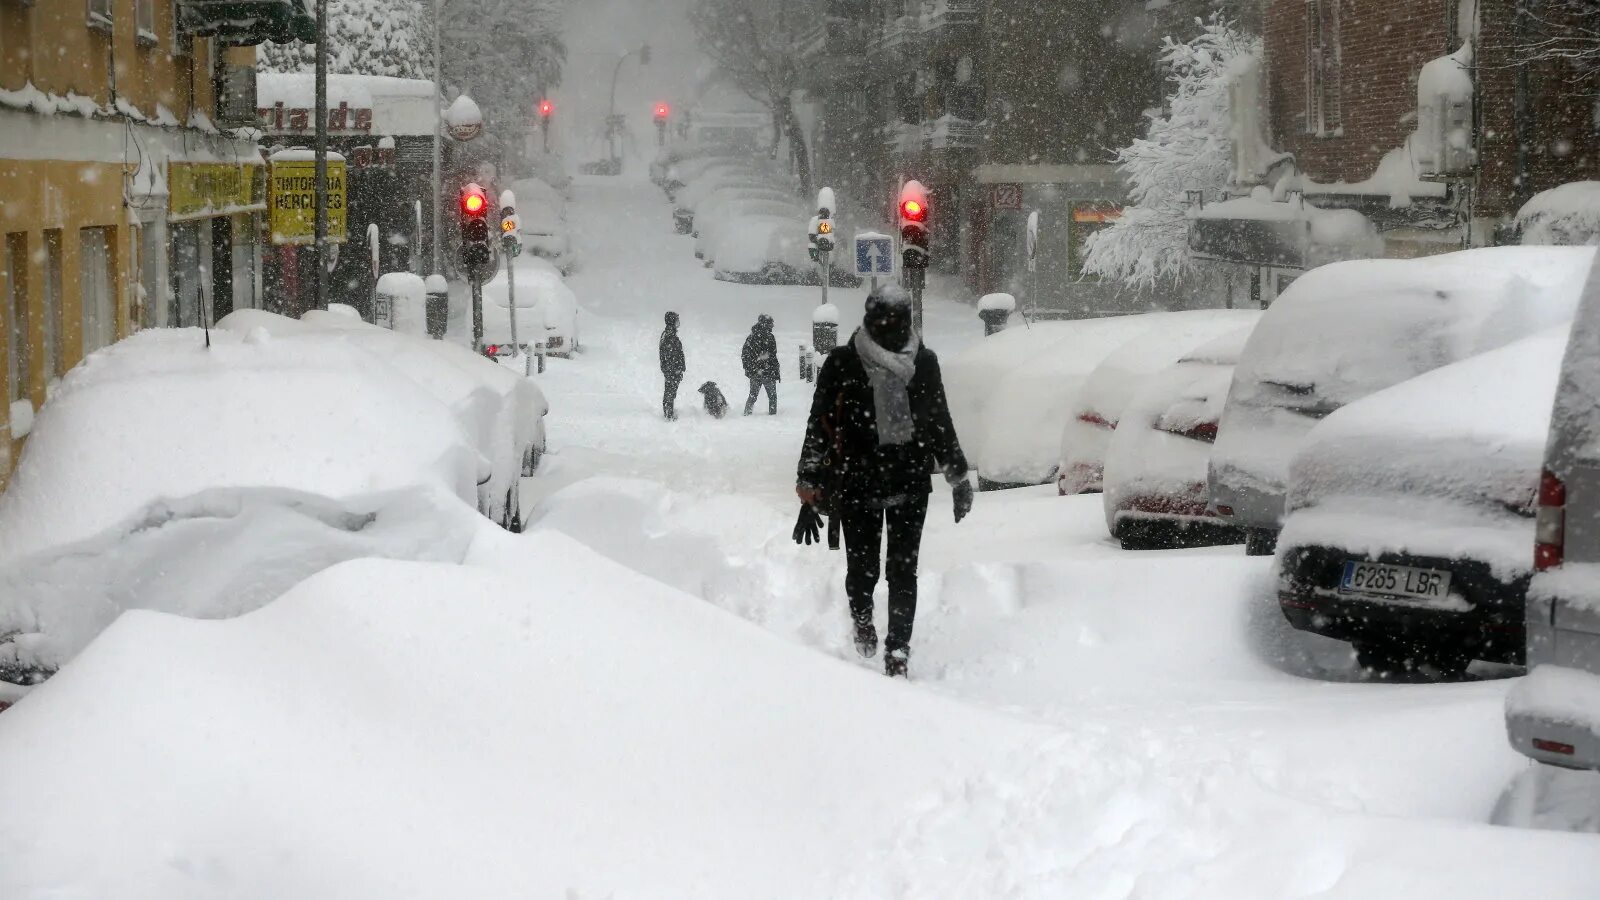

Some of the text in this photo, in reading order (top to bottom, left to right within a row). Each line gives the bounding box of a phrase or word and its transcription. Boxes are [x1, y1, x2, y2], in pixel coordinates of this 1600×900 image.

[275, 176, 342, 190] TINTORRIA
[275, 194, 342, 209] HERCUES
[1404, 570, 1441, 596] LBR
